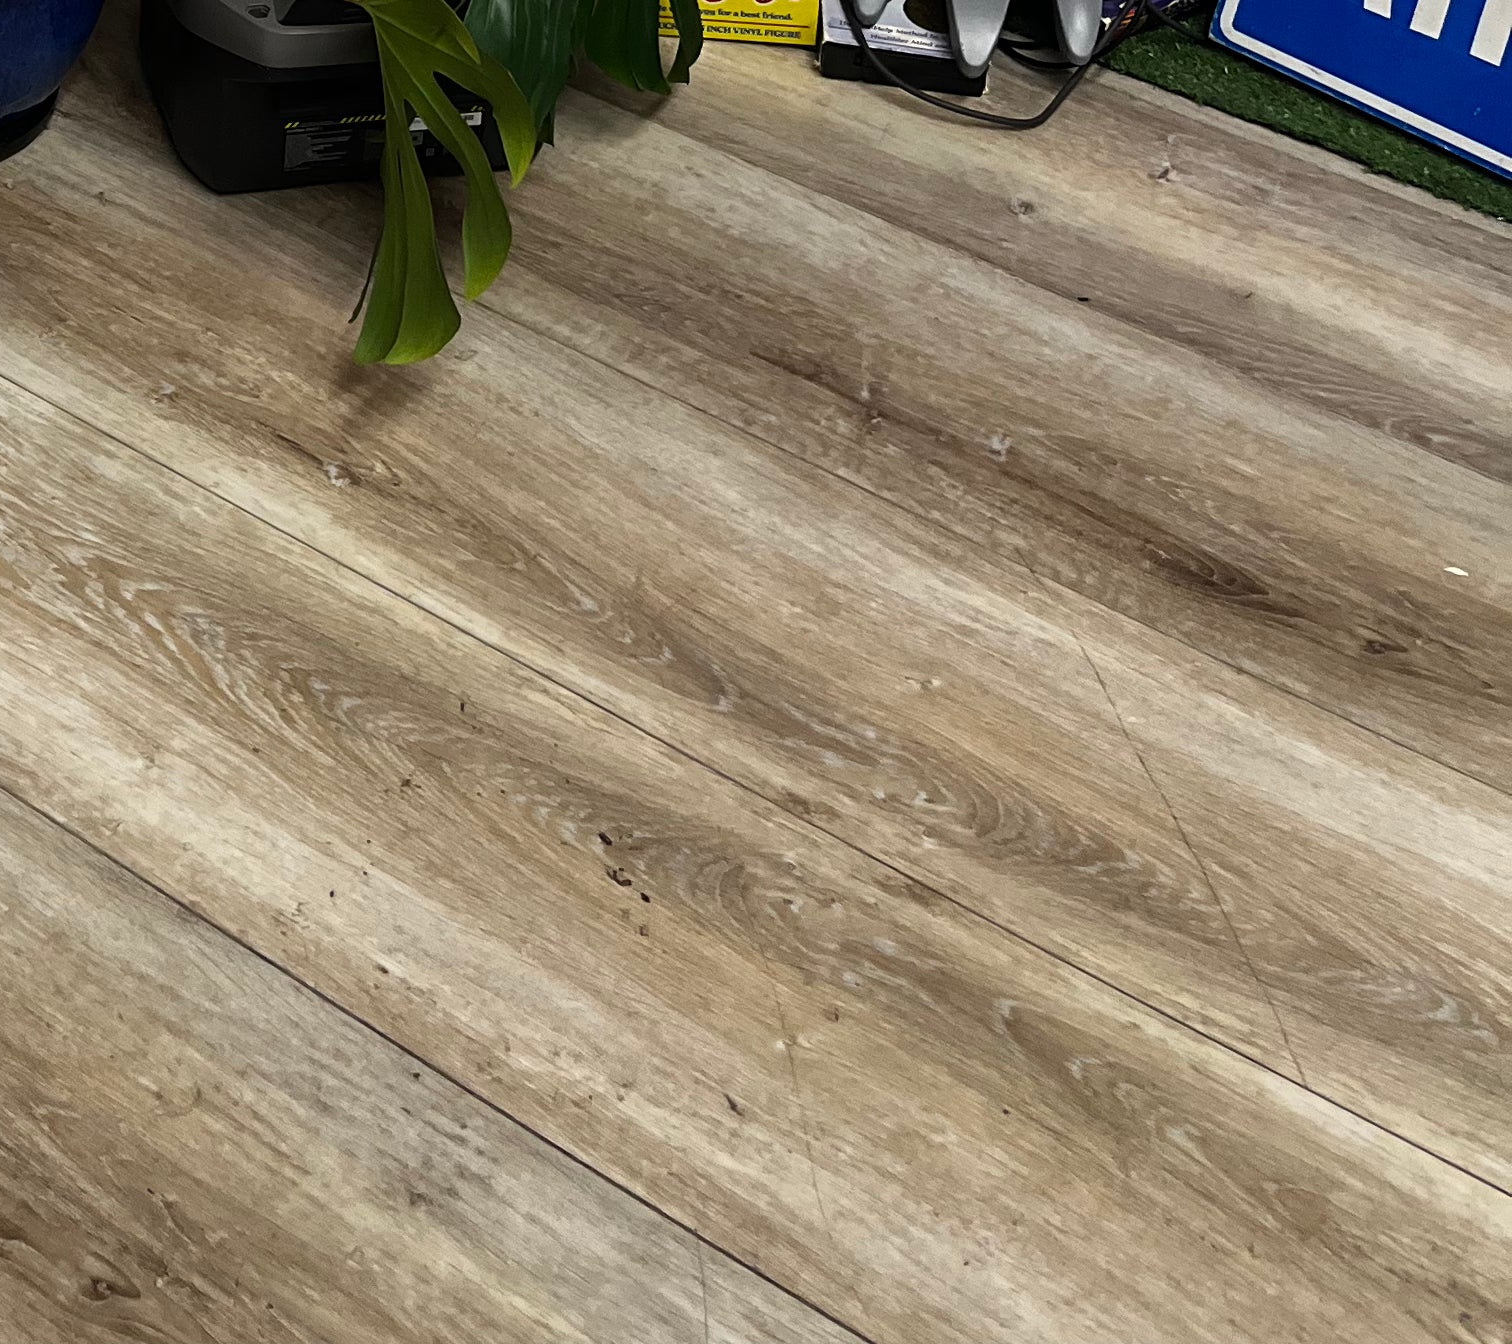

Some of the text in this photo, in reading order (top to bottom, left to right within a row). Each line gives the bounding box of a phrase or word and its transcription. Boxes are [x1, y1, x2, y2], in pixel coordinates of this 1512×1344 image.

[740, 10, 760, 19] best
[762, 11, 793, 21] friend.
[707, 26, 731, 34] INCH
[733, 27, 762, 37] VINYL
